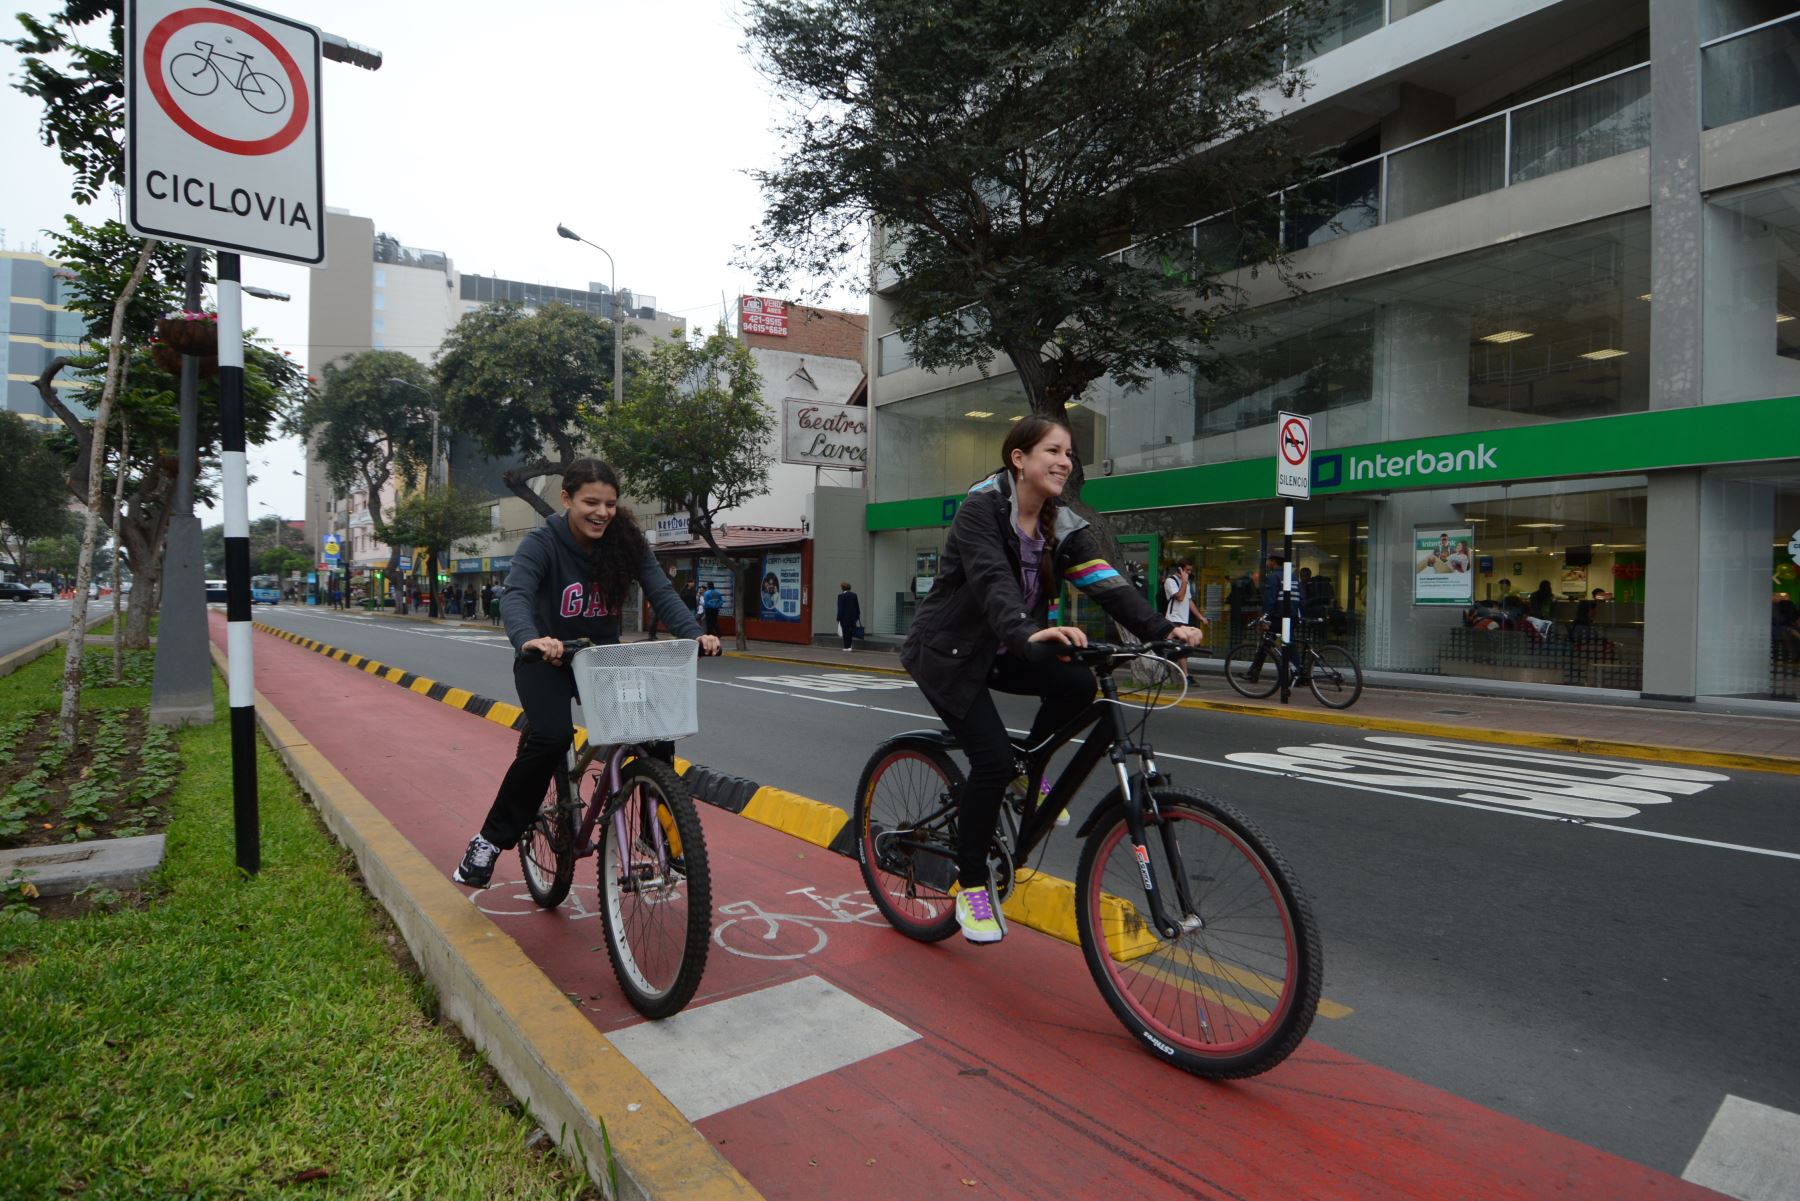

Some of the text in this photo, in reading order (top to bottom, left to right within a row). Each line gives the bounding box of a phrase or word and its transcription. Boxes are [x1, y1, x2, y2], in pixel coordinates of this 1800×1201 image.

[146, 169, 312, 230] CICLOVIA
[798, 407, 866, 434] Teatro
[1349, 442, 1497, 481] Interbank
[1280, 474, 1307, 488] SILENCIO
[560, 582, 615, 618] GA
[1224, 736, 1731, 819] SOLO
